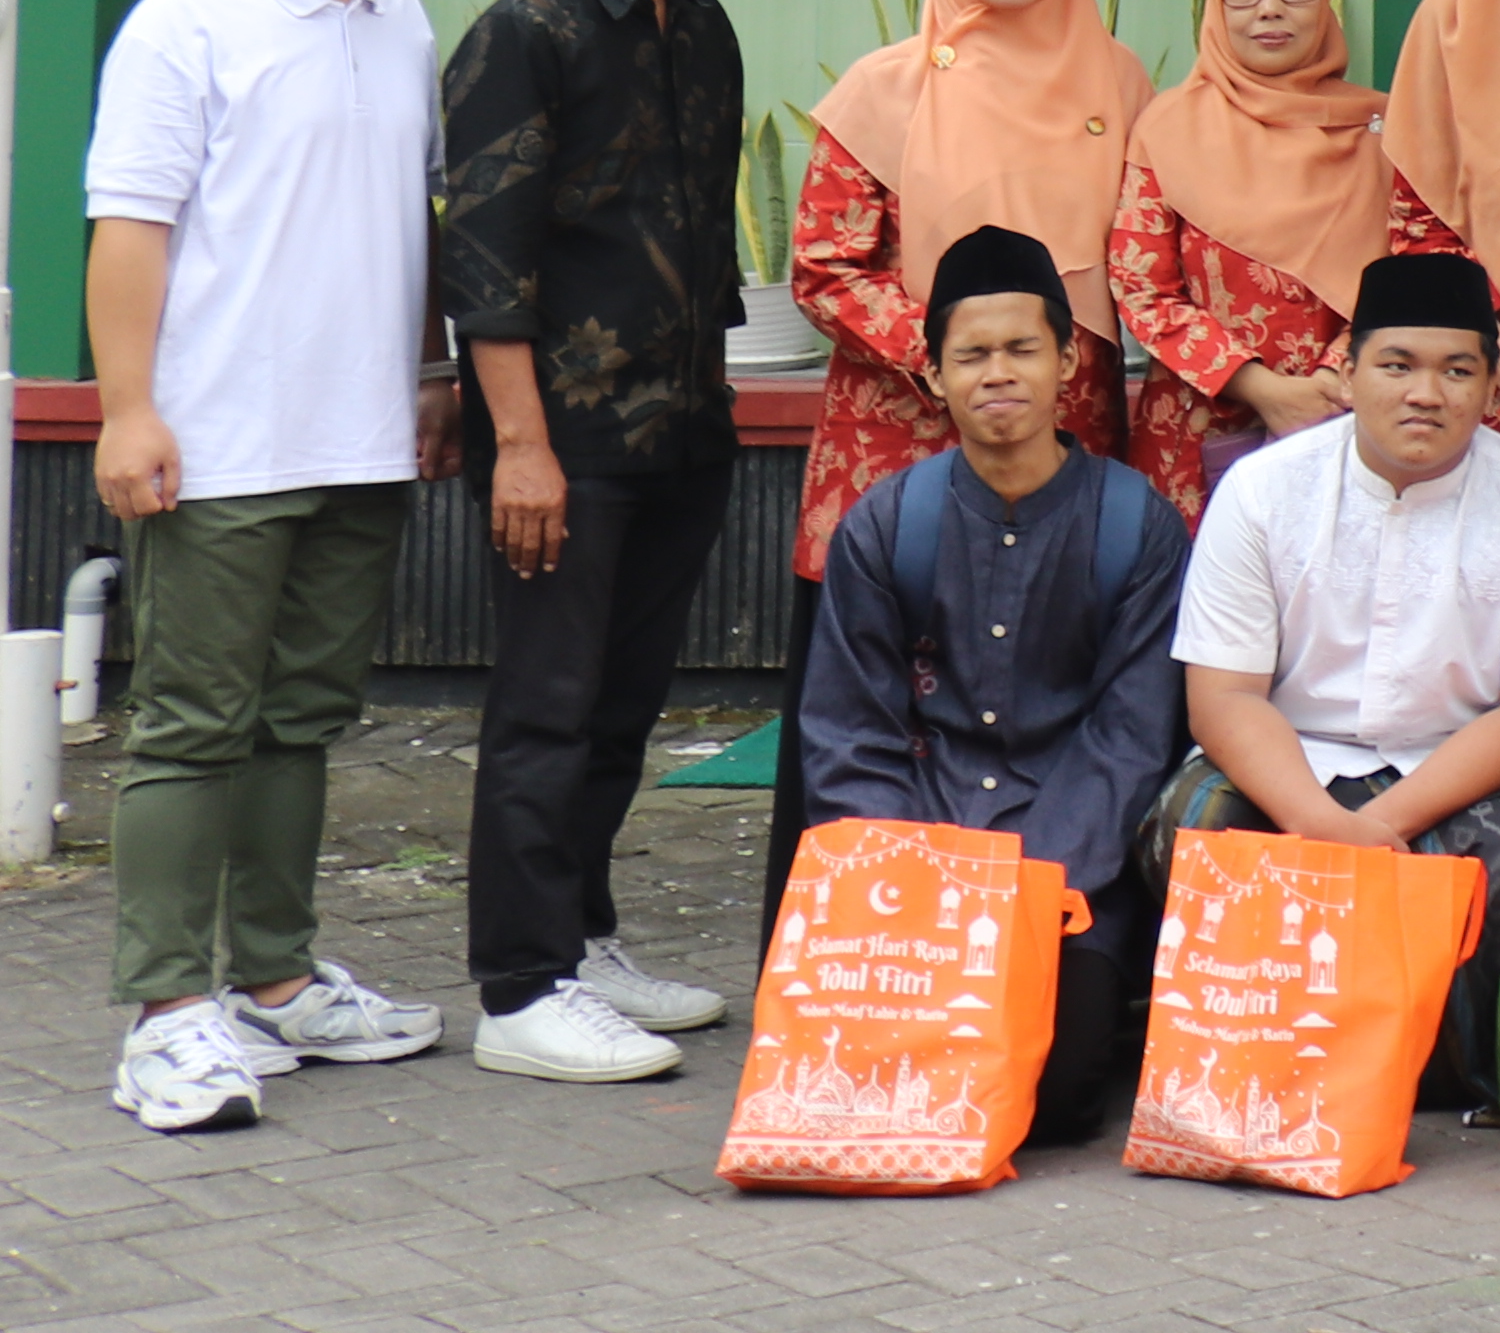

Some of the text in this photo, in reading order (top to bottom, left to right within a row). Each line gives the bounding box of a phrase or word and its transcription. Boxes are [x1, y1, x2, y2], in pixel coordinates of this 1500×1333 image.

[864, 932, 908, 958] Hari
[912, 938, 958, 965] Raya
[816, 961, 933, 996] Idul Fitri
[1260, 958, 1302, 983] Raya
